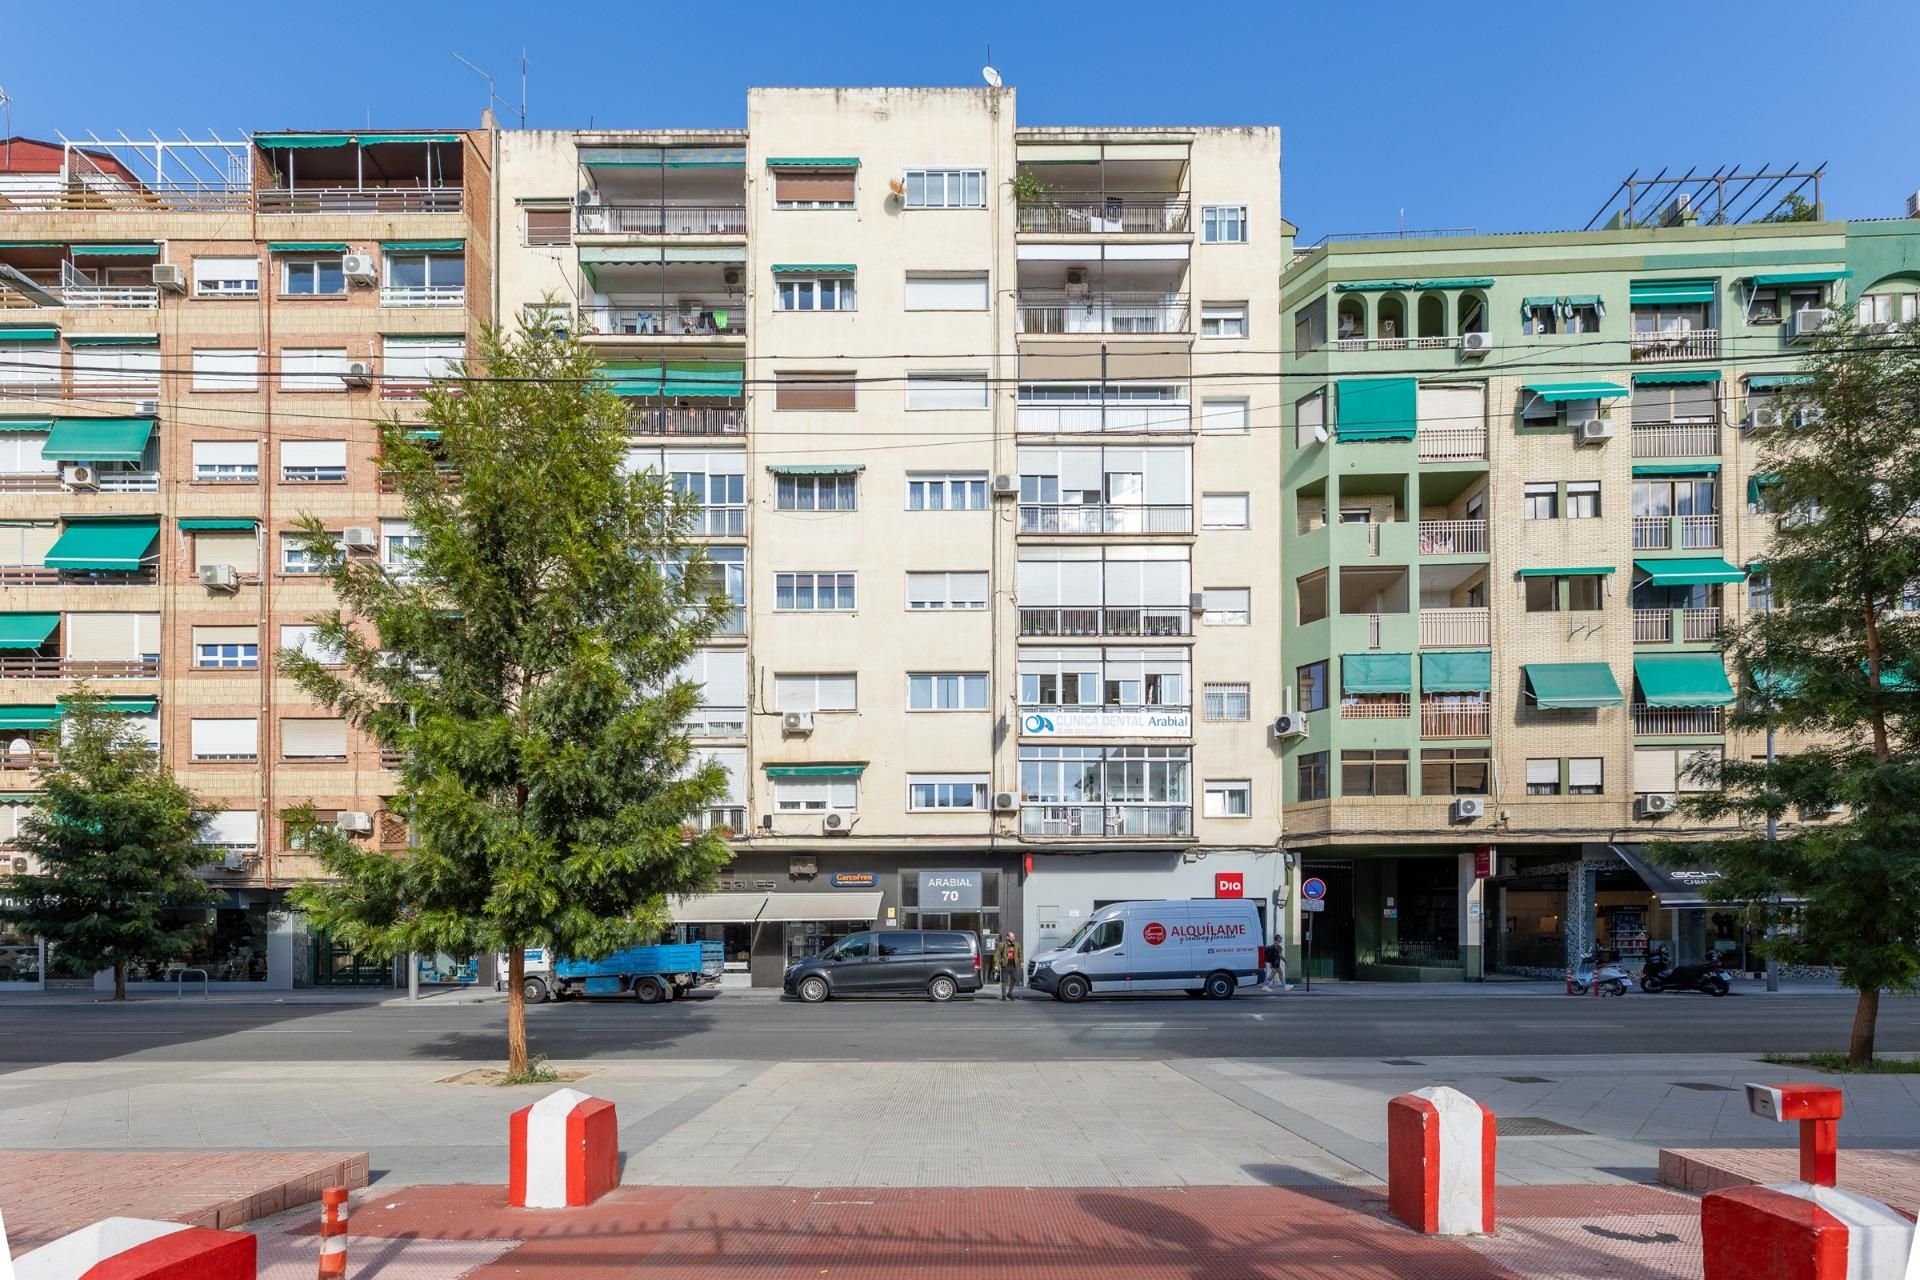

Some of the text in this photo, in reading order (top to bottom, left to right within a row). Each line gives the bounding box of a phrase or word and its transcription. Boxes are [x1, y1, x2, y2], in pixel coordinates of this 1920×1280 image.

[1148, 715, 1188, 727] Arabial
[927, 878, 973, 887] ARABIAL
[941, 890, 959, 902] 70
[1171, 922, 1246, 937] ALQUÍLAME
